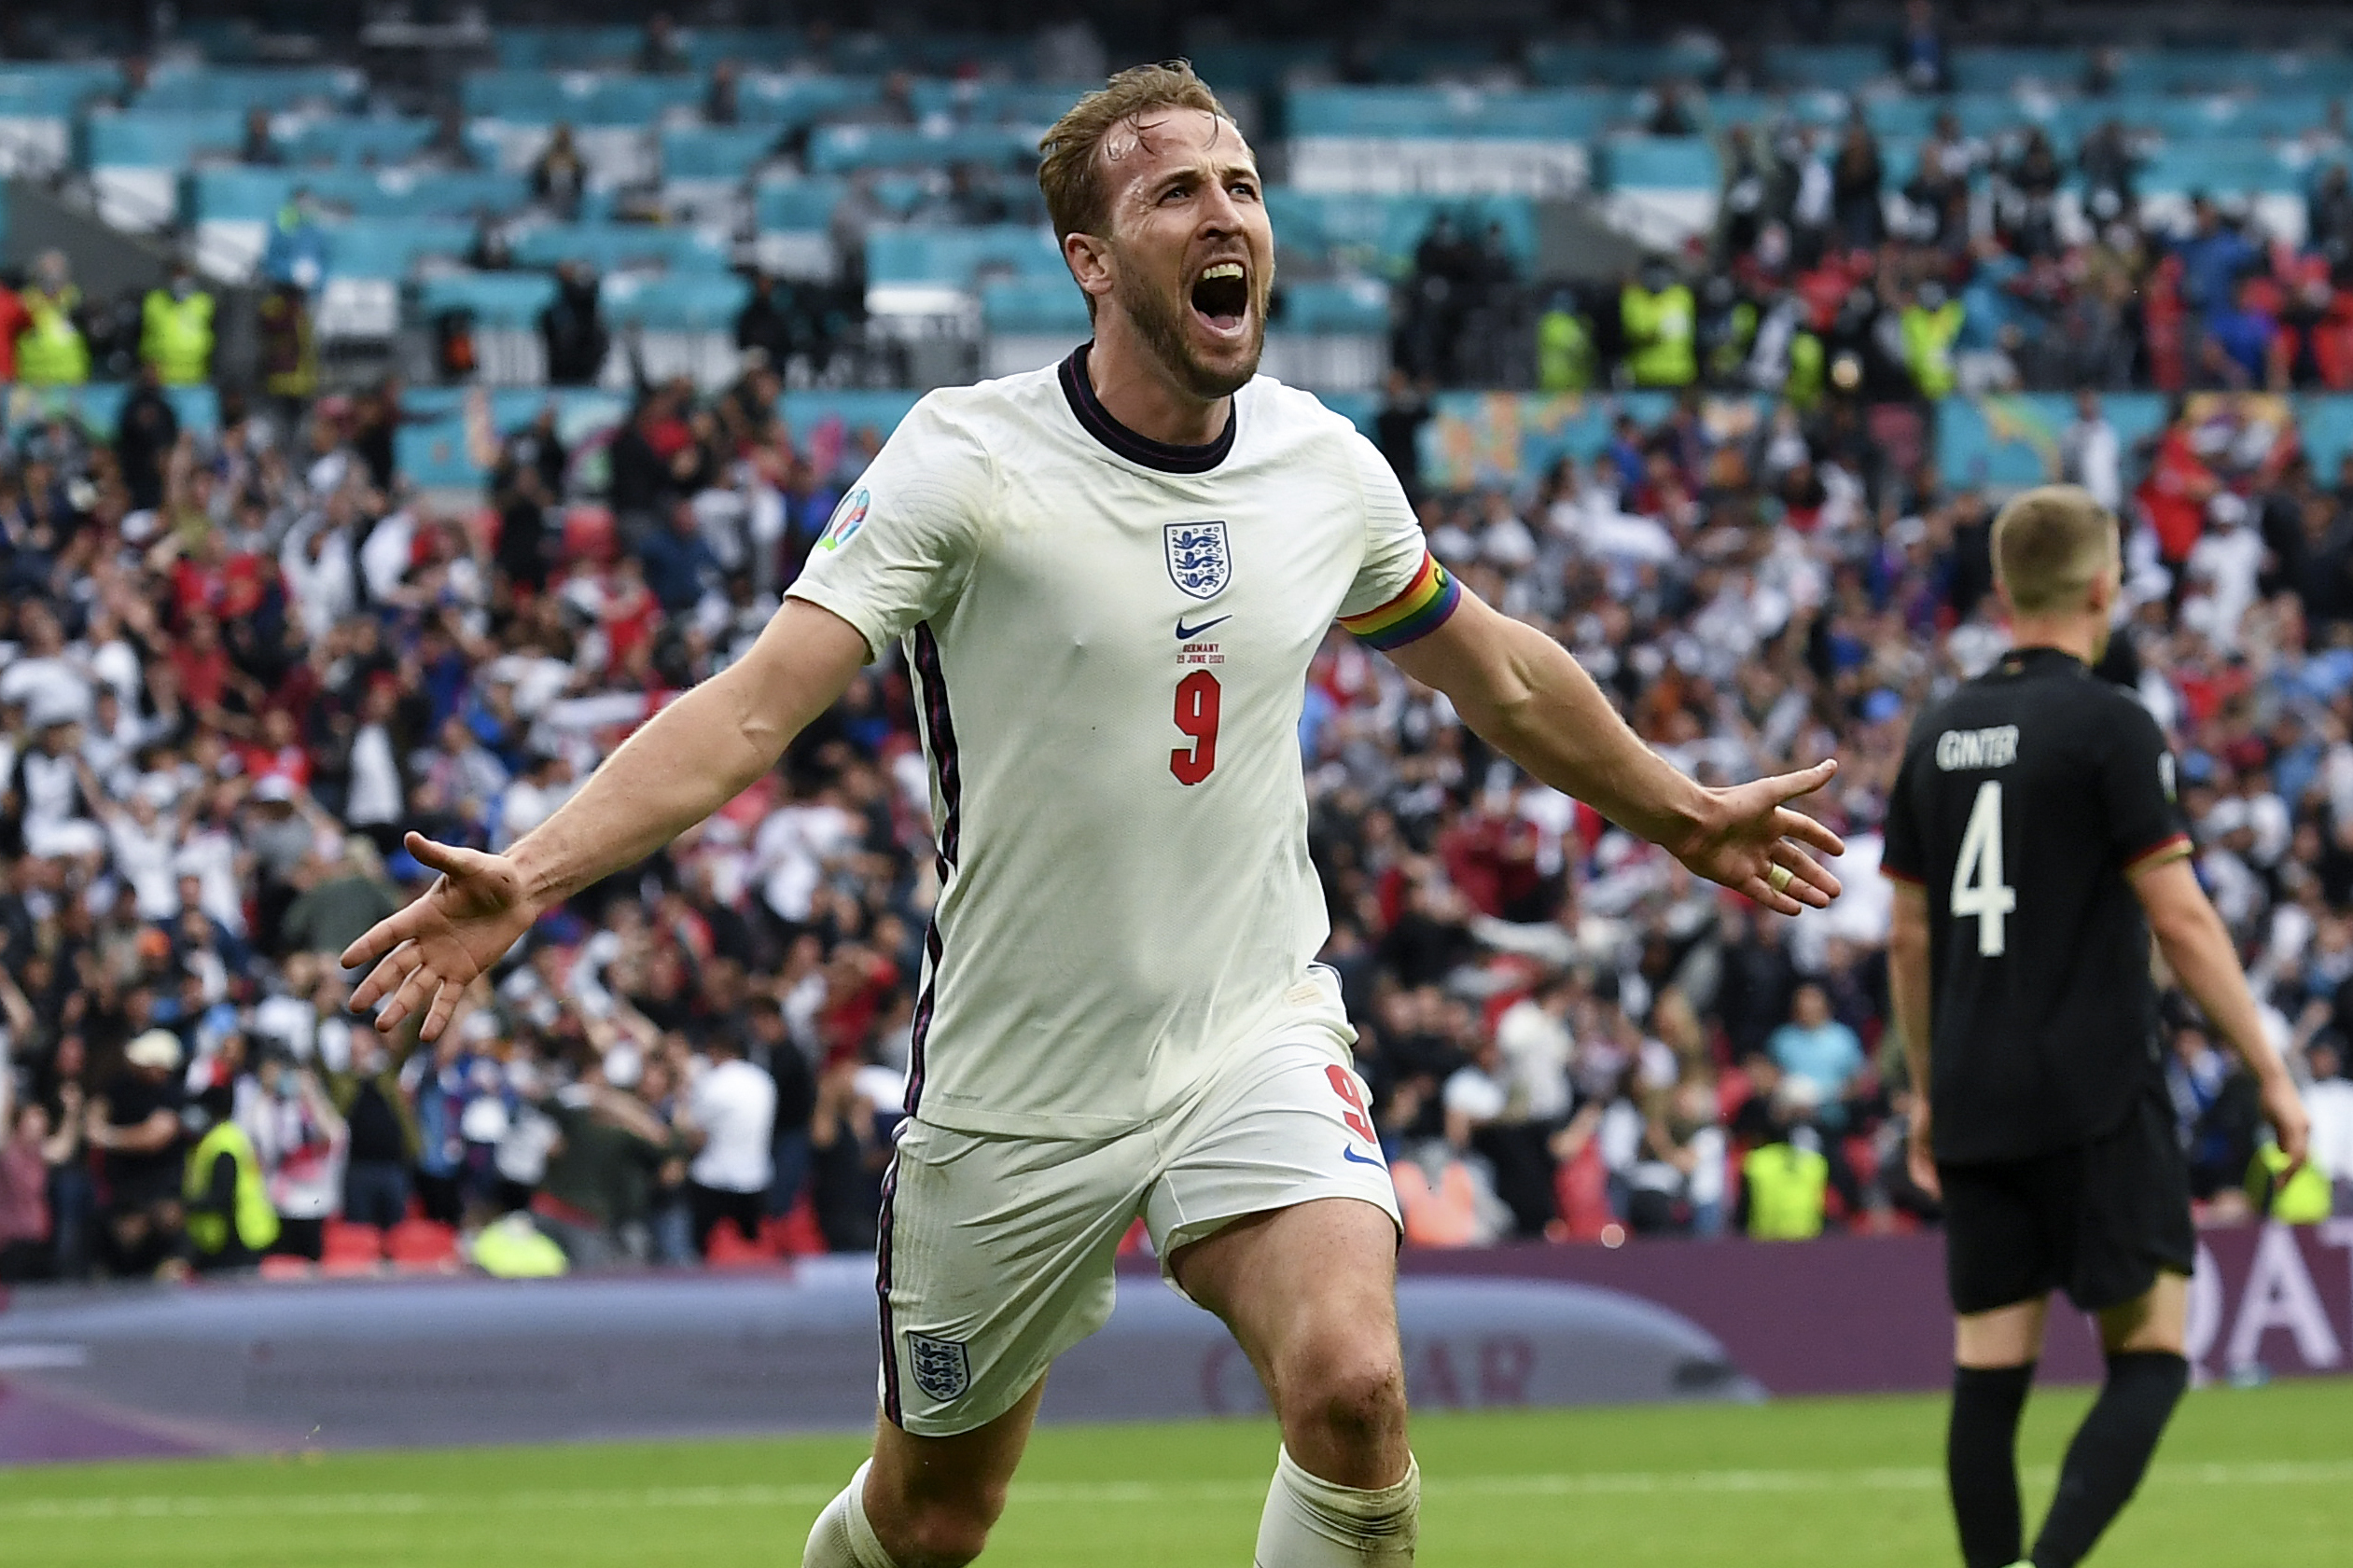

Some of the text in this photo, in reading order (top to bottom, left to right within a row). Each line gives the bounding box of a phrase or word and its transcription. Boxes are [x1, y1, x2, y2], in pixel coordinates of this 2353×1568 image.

[1176, 654, 1225, 664] 29 JUNE 2021
[1182, 643, 1219, 653] GERMANY
[1170, 669, 1221, 785] 9
[1936, 724, 2020, 772] GINTER
[1950, 779, 2017, 957] 4
[1325, 1063, 1376, 1145] 9
